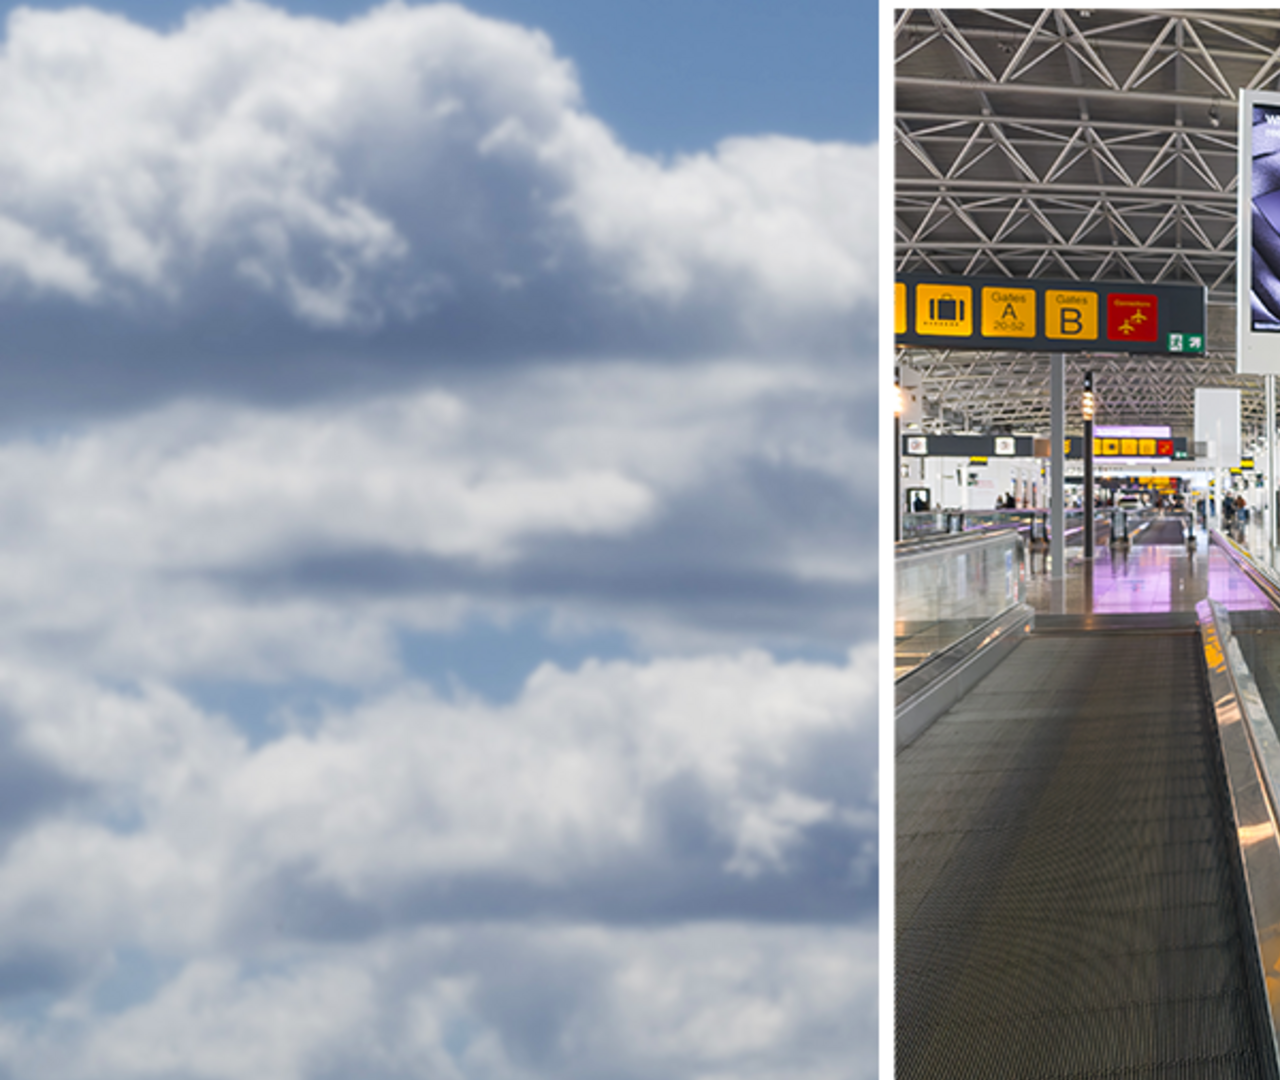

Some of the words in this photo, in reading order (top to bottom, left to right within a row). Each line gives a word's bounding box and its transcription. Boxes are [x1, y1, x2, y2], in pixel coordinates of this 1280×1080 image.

[991, 291, 1026, 304] Gates
[1056, 294, 1088, 305] Gates
[1002, 303, 1017, 319] A
[993, 320, 1025, 331] 20-52
[1060, 307, 1083, 335] B
